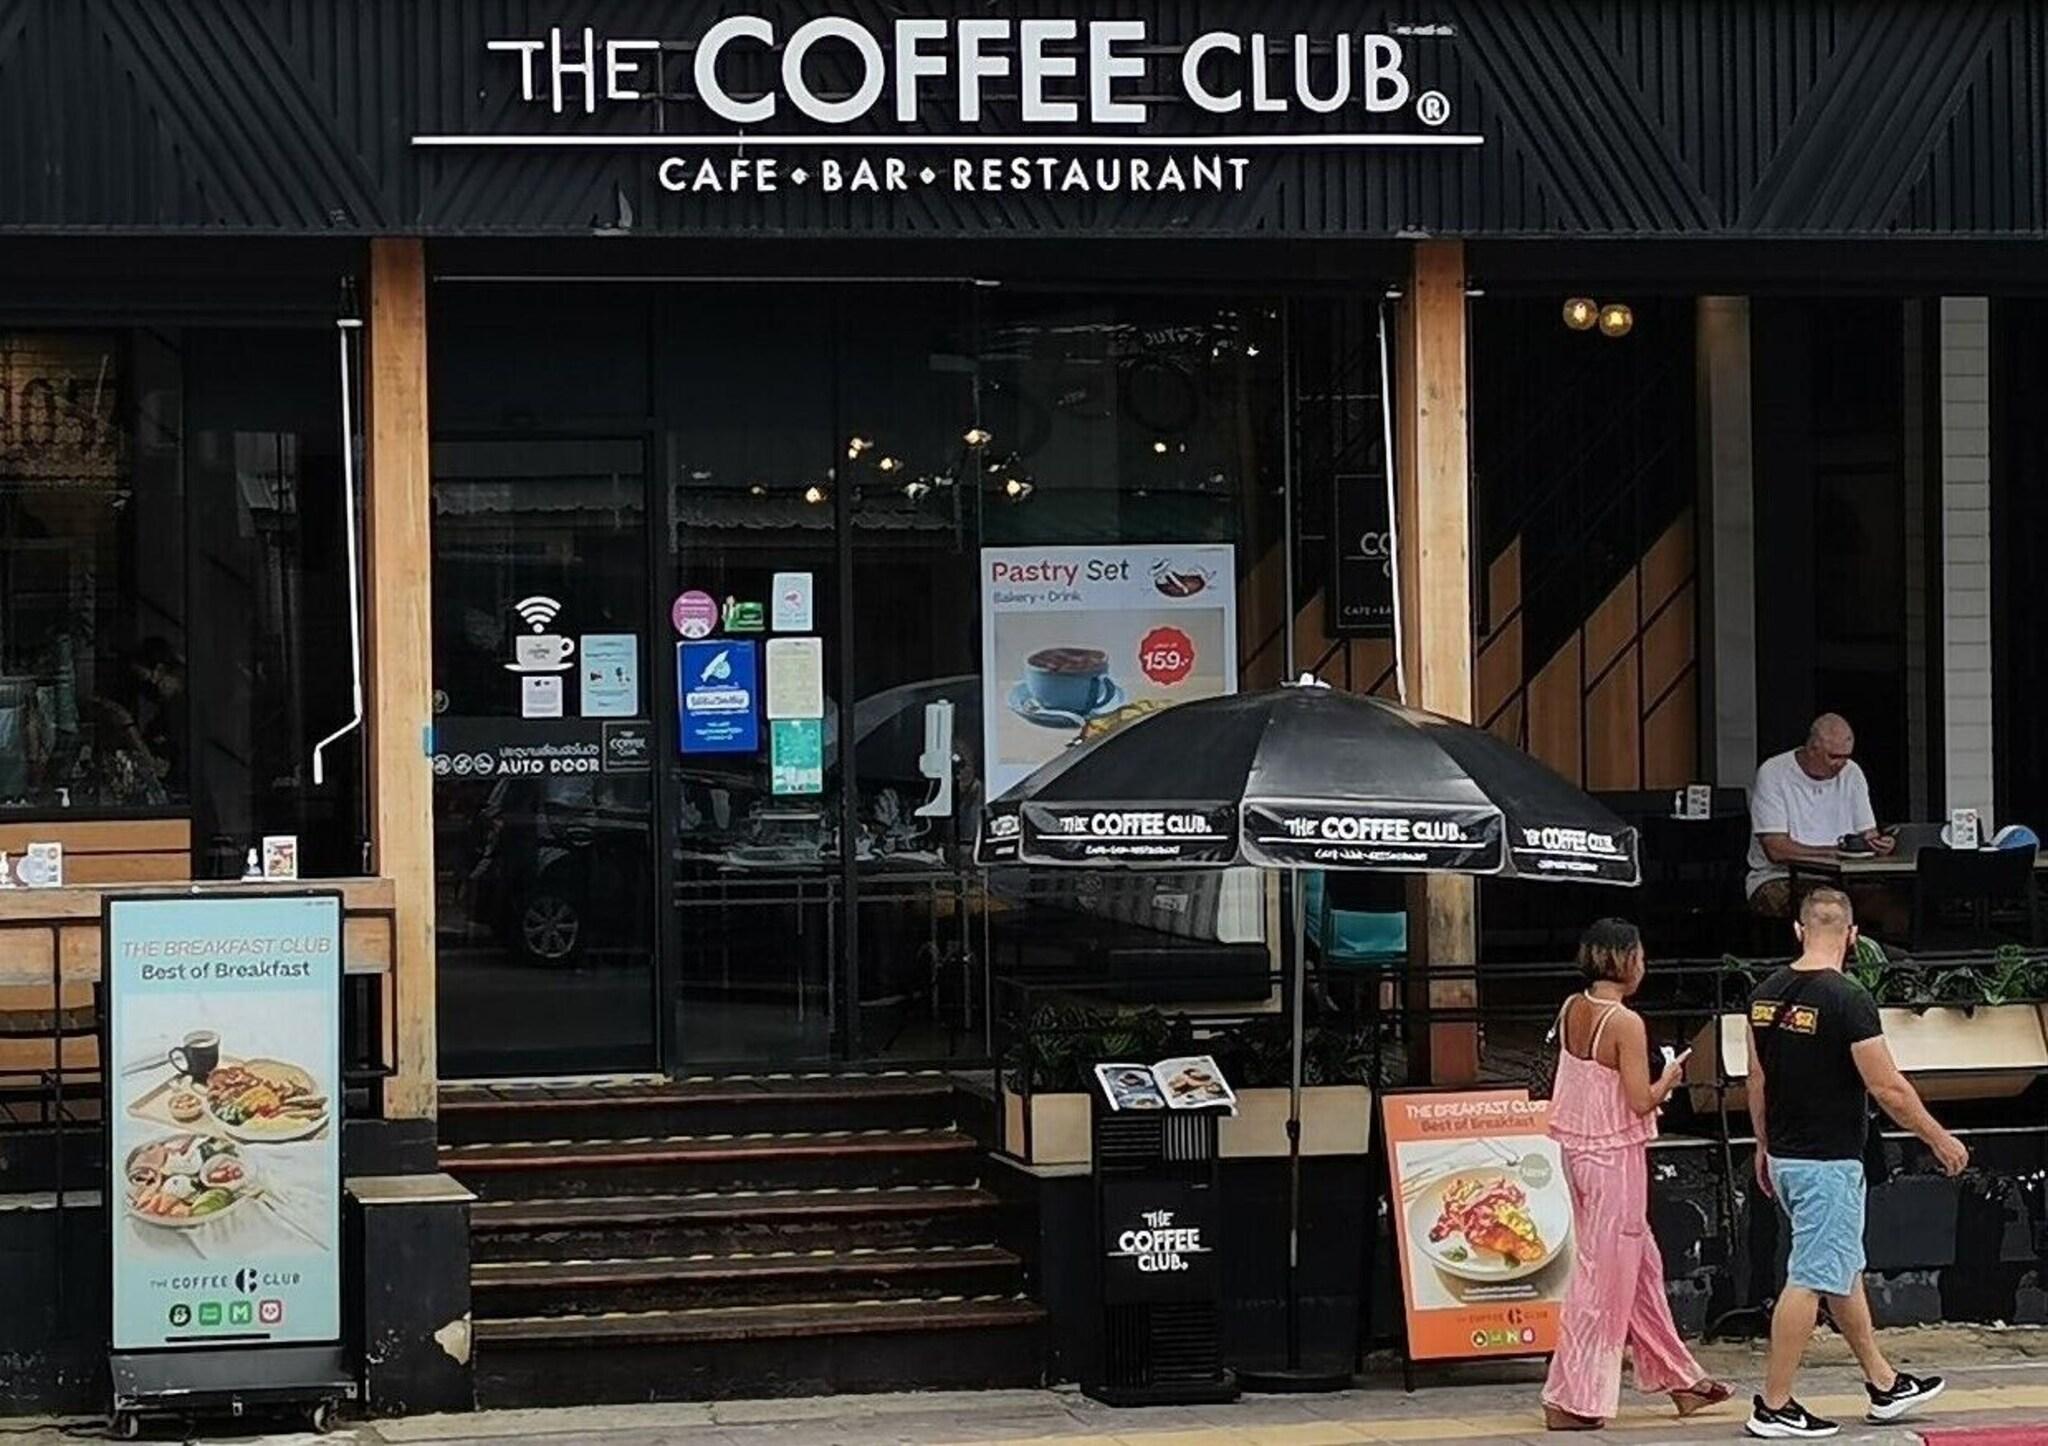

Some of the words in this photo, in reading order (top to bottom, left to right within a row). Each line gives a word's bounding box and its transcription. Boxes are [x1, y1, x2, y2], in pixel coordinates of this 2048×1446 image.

[487, 27, 661, 113] THE
[694, 16, 1147, 123] COFFEE
[659, 157, 778, 192] CAFE
[822, 157, 908, 192] BAR
[953, 155, 1250, 193] RESTAURANT
[992, 560, 1079, 586] Pastry
[1087, 558, 1130, 581] Set
[1048, 590, 1082, 603] Drink
[497, 758, 544, 775] AUTO
[549, 758, 600, 773] DOOR
[1091, 813, 1165, 835] COFFEE
[1284, 817, 1319, 837] THE
[1321, 817, 1410, 841] COFFEE
[123, 941, 160, 957] THE
[164, 938, 275, 956] BREAKFAST
[280, 937, 332, 954] CLUB
[142, 963, 186, 980] Best
[190, 962, 209, 979] of
[215, 961, 311, 978] Breakfast
[1405, 1103, 1433, 1119] THE
[1434, 1100, 1509, 1118] BREAKFAST
[1141, 1209, 1175, 1228] THE
[1119, 1229, 1200, 1252] COFFEE
[172, 1275, 228, 1289] COFFEE
[263, 1273, 301, 1286] CLUB
